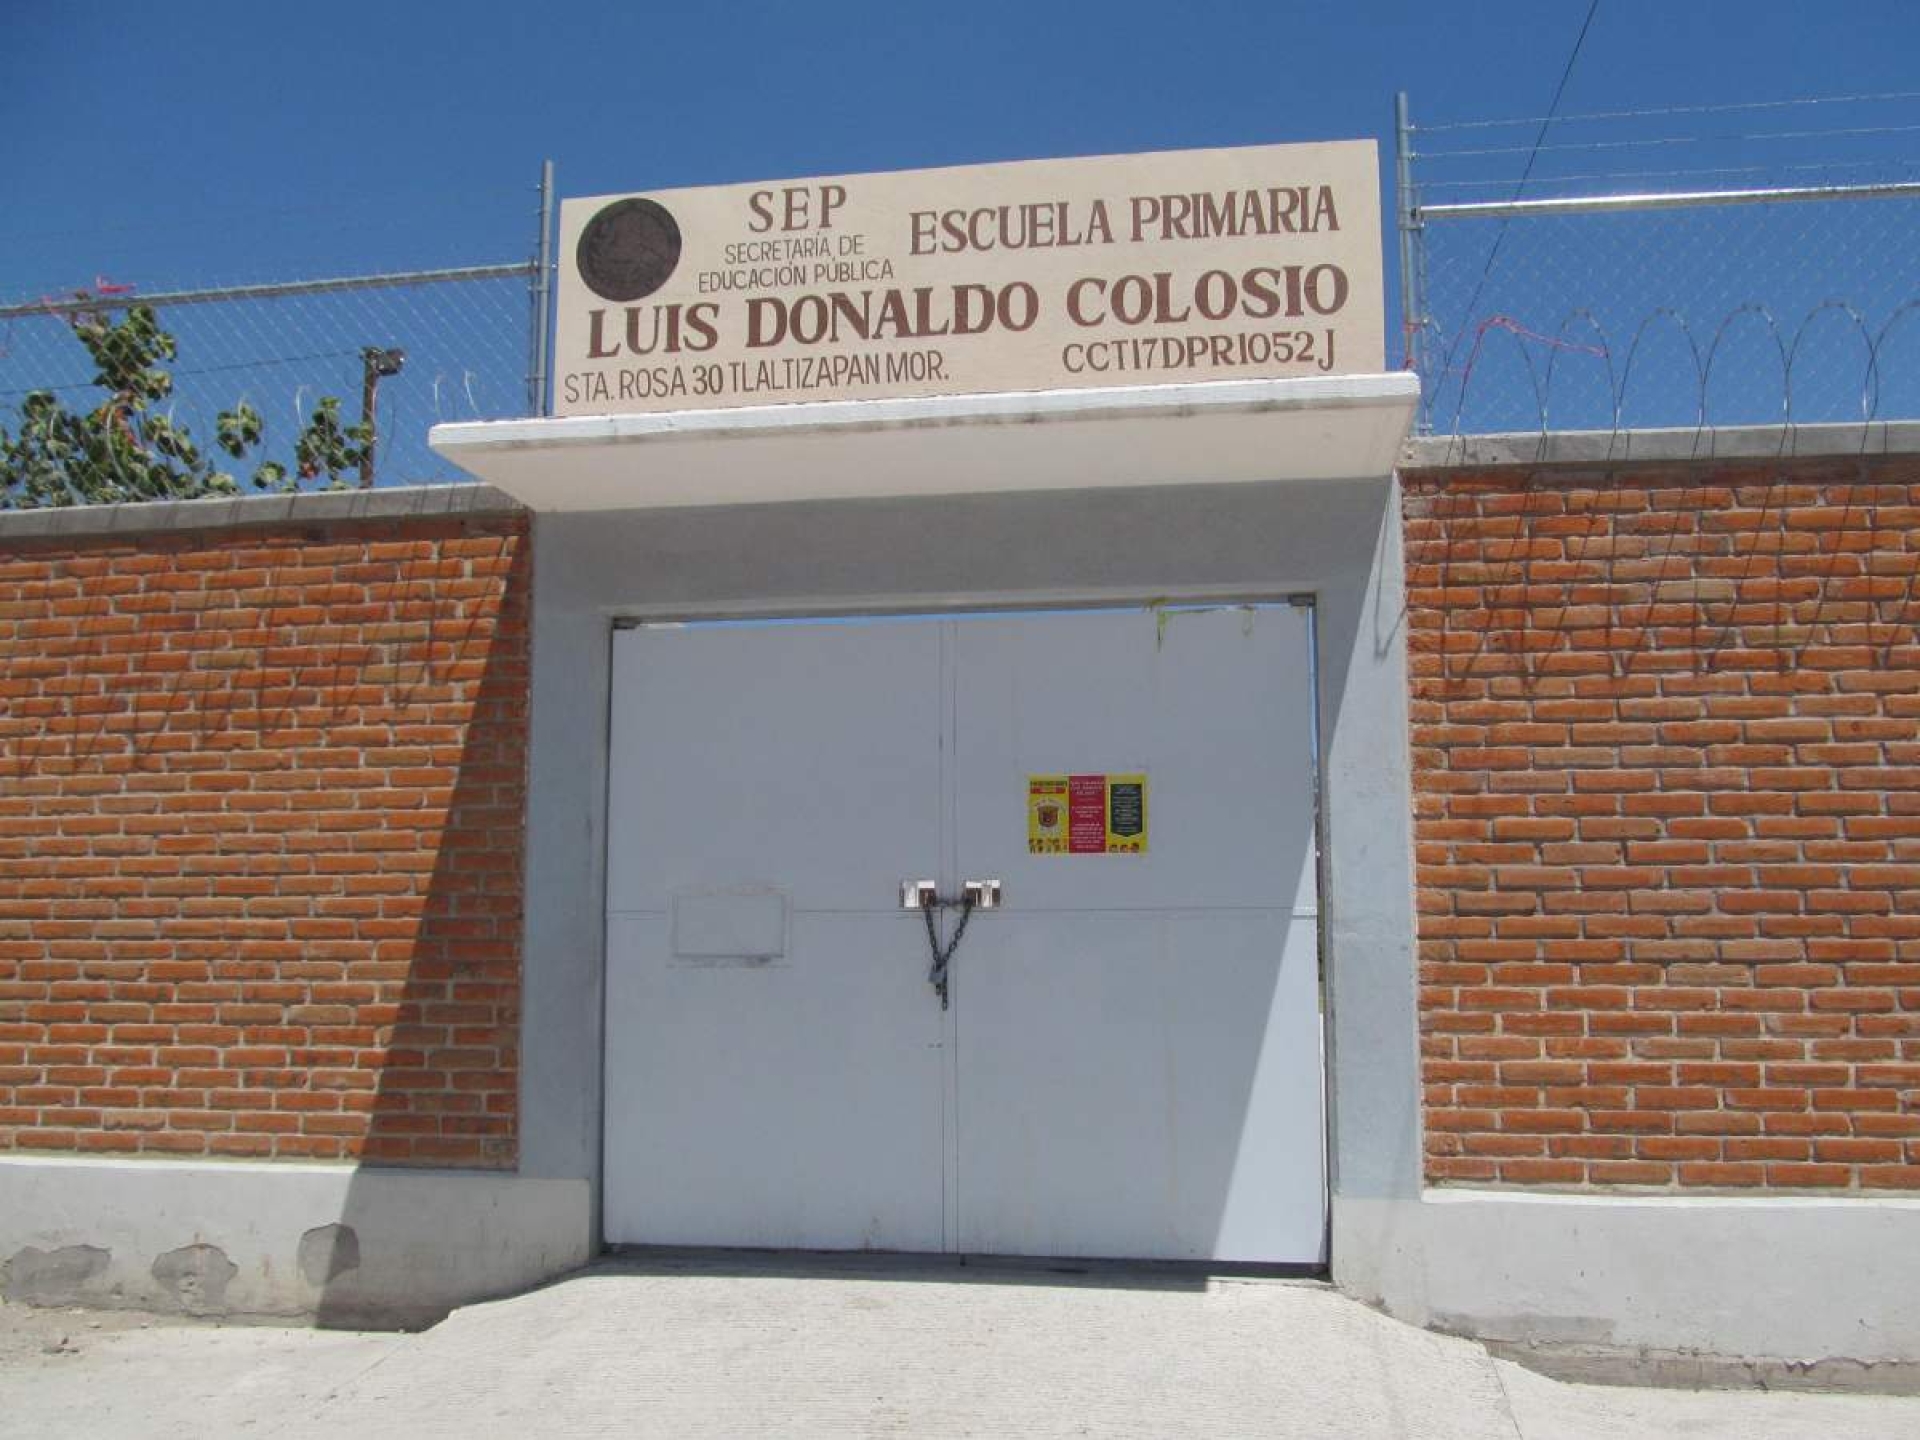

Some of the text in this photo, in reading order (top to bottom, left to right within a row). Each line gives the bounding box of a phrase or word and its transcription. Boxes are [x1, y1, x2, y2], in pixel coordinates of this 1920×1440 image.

[748, 185, 846, 233] SEP
[909, 185, 1340, 255] ESCUELA PRIMARIA
[724, 232, 865, 264] SECRETARÍA DE
[699, 257, 894, 293] EDUCACIÓN PÚBLICA
[586, 263, 1349, 359] LUIS DONALDO COLOSIO
[564, 350, 949, 403] STA. ROSA 30 TLALTIZAPAN MOR.
